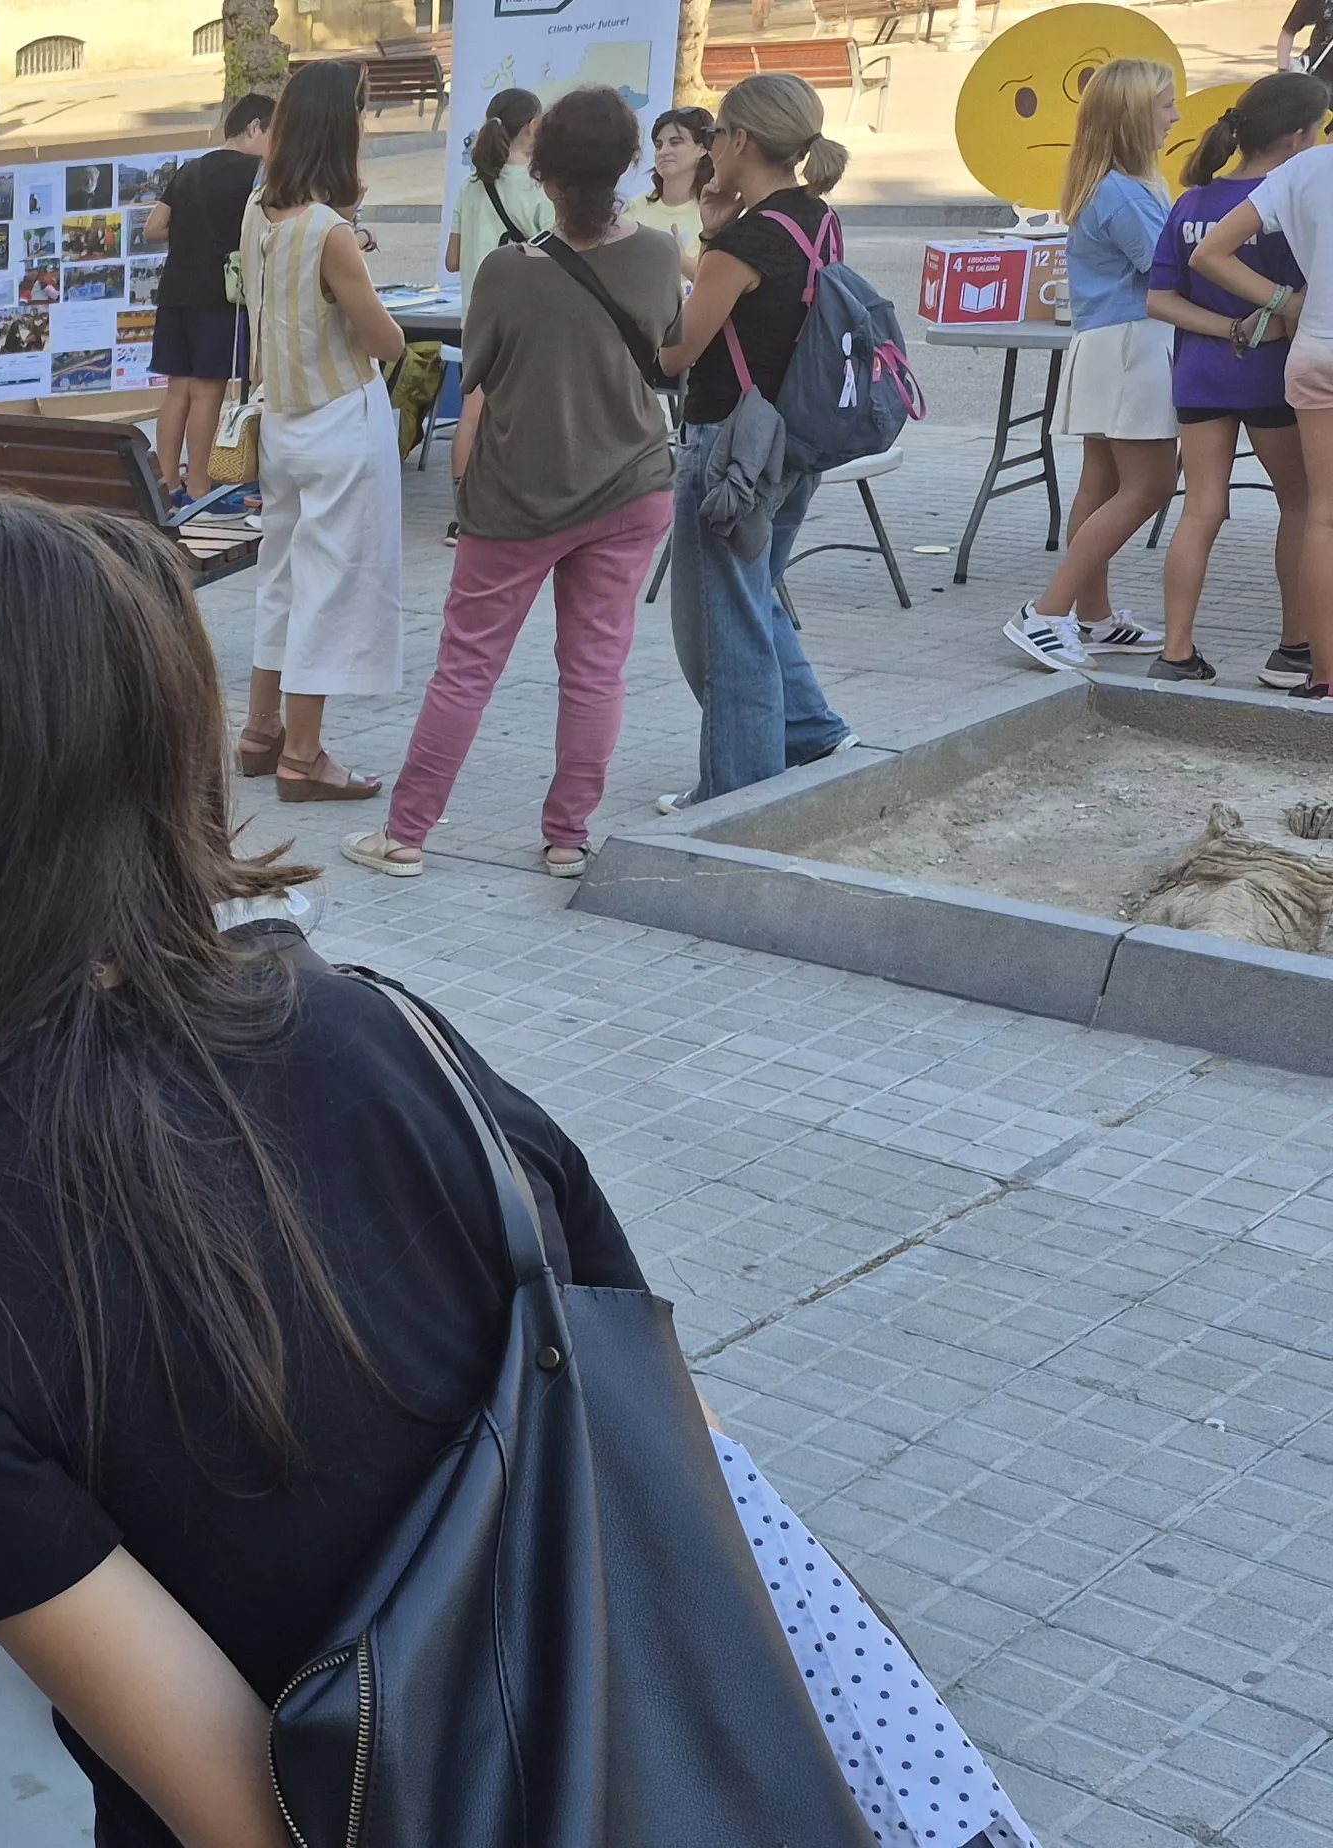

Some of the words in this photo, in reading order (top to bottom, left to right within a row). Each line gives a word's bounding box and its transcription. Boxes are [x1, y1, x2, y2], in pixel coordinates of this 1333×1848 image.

[547, 25, 573, 35] Climb
[575, 22, 596, 33] your
[597, 16, 630, 30] future!
[952, 257, 964, 272] 4
[967, 255, 1001, 264] EDUCACIÓN
[1033, 250, 1050, 267] 12
[975, 264, 1000, 272] CALIDAD
